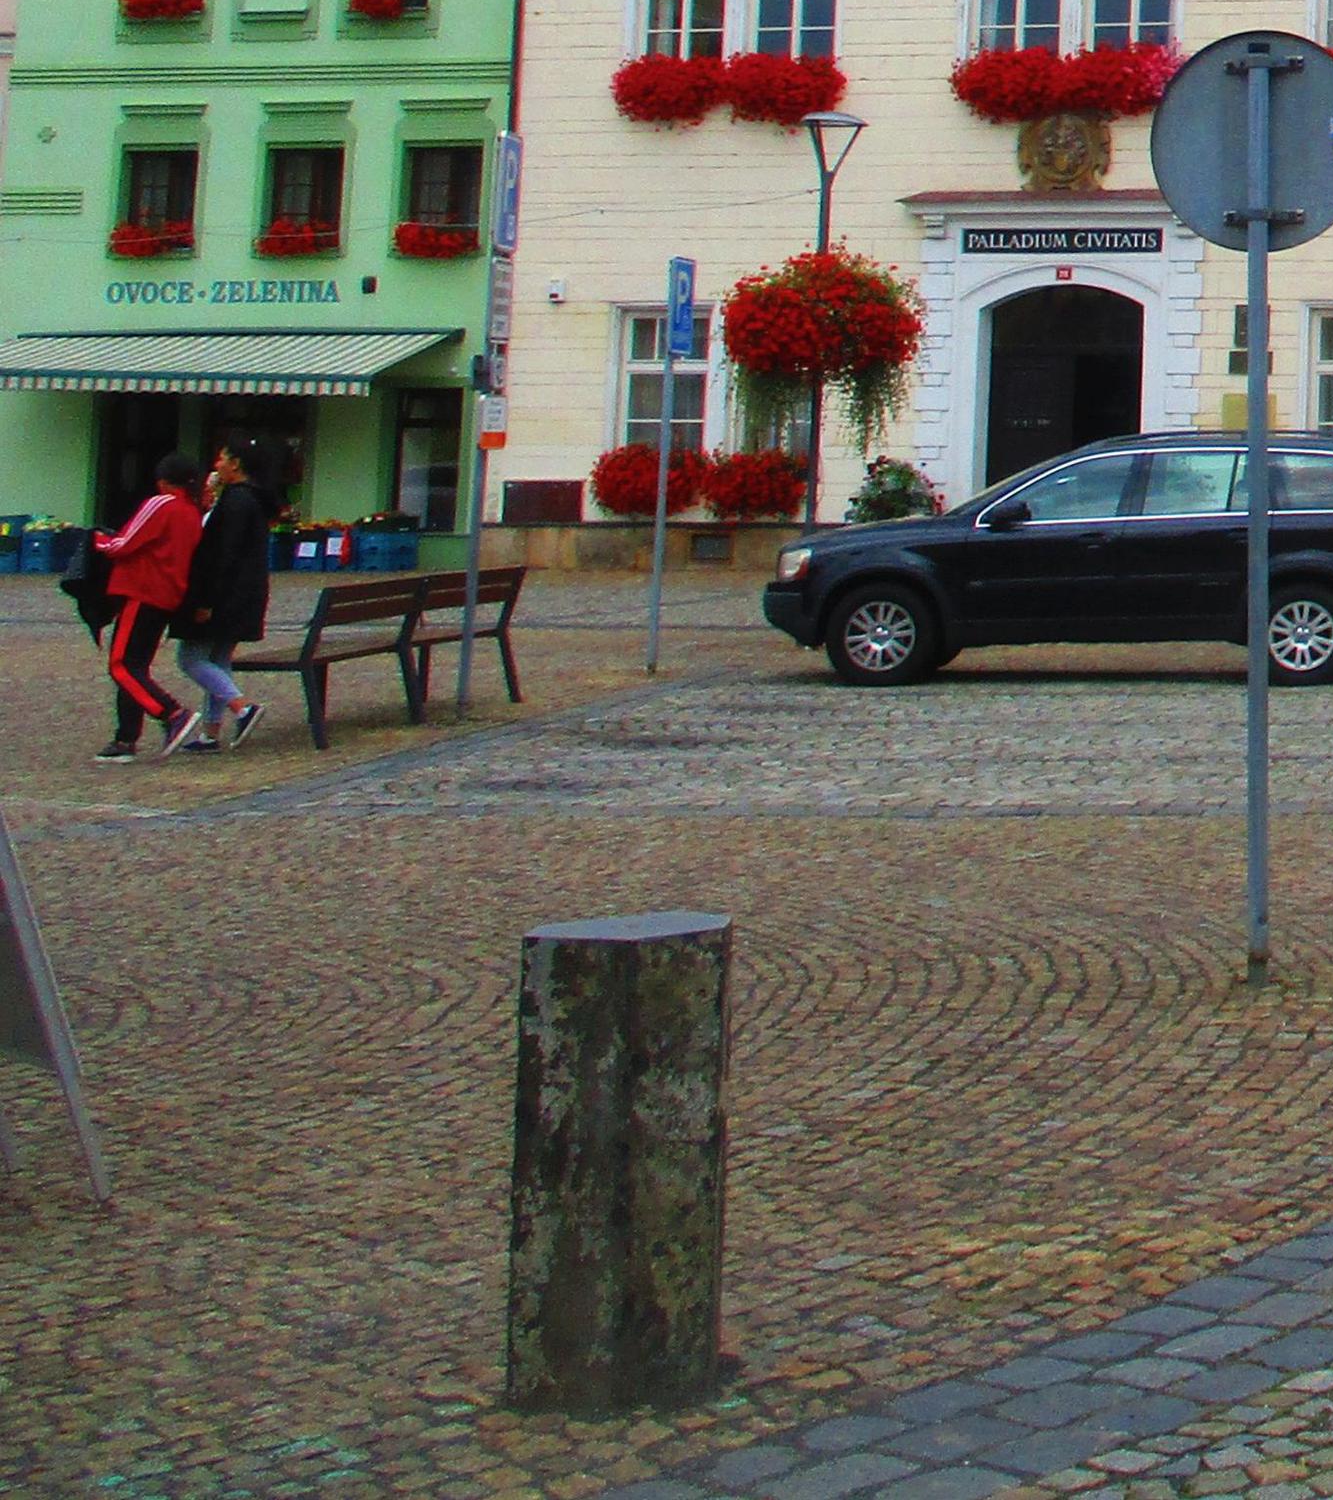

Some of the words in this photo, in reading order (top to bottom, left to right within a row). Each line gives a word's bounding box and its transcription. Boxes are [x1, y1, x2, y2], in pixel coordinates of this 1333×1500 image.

[967, 233, 1067, 249] PALLADIUM
[1074, 232, 1157, 248] CIVITATIS
[106, 280, 194, 304] OVOCE
[211, 279, 341, 303] ZELENINA
[675, 271, 690, 324] P
